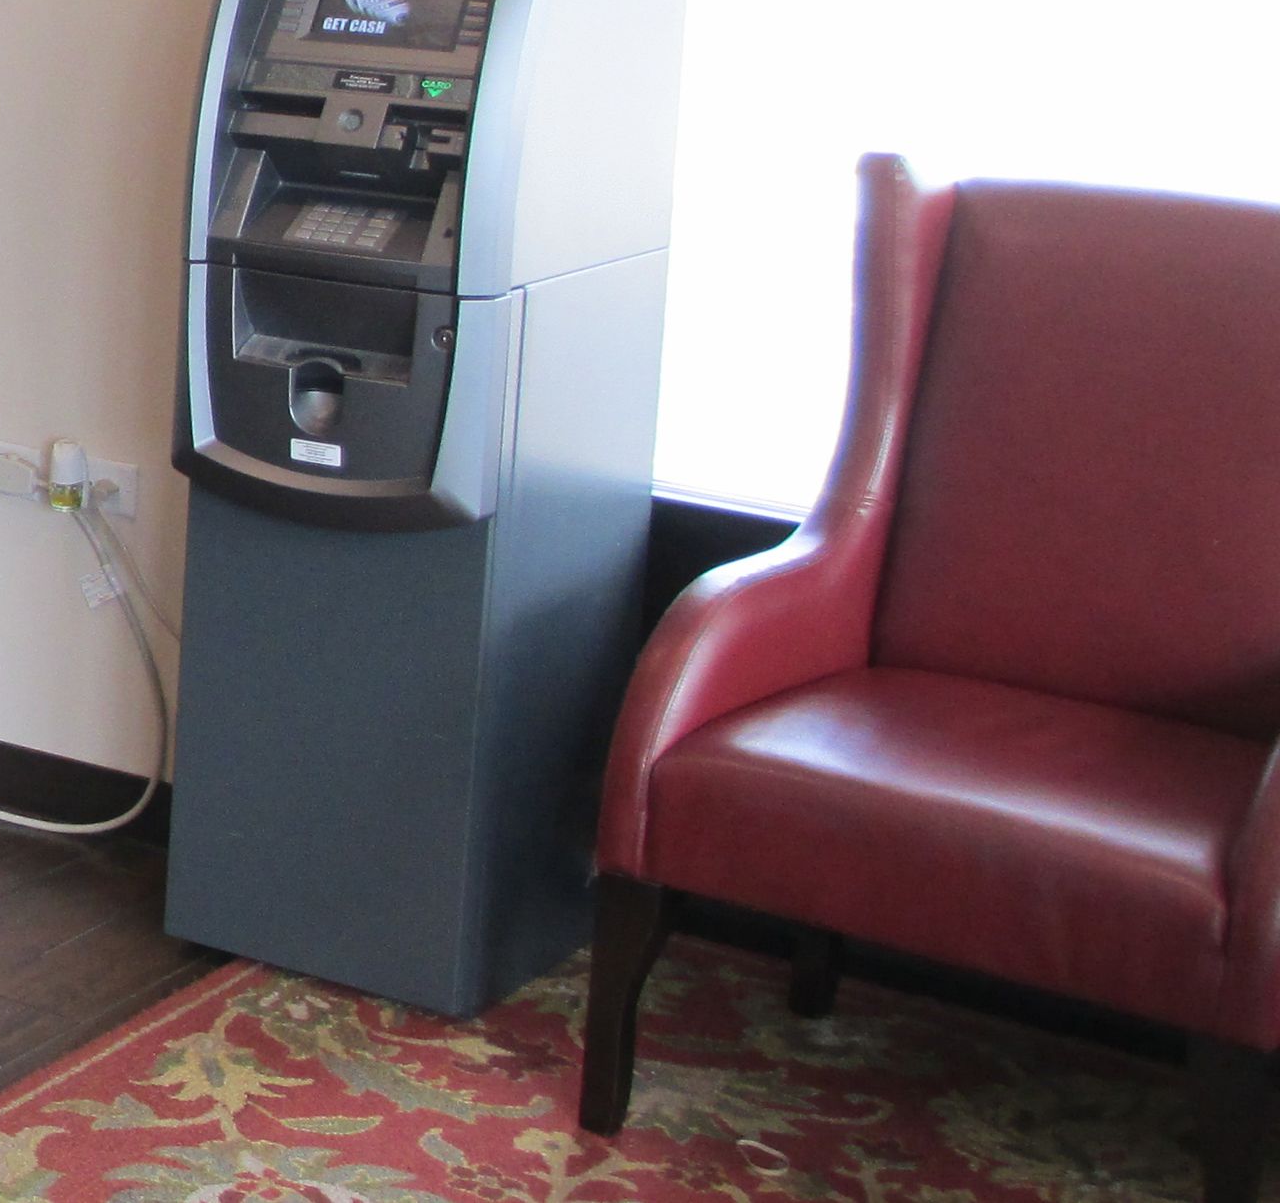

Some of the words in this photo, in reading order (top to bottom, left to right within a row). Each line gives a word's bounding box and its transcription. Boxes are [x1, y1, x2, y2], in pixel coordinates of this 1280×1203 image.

[323, 16, 348, 31] GET
[349, 19, 387, 35] CASH
[421, 79, 453, 90] CARD
